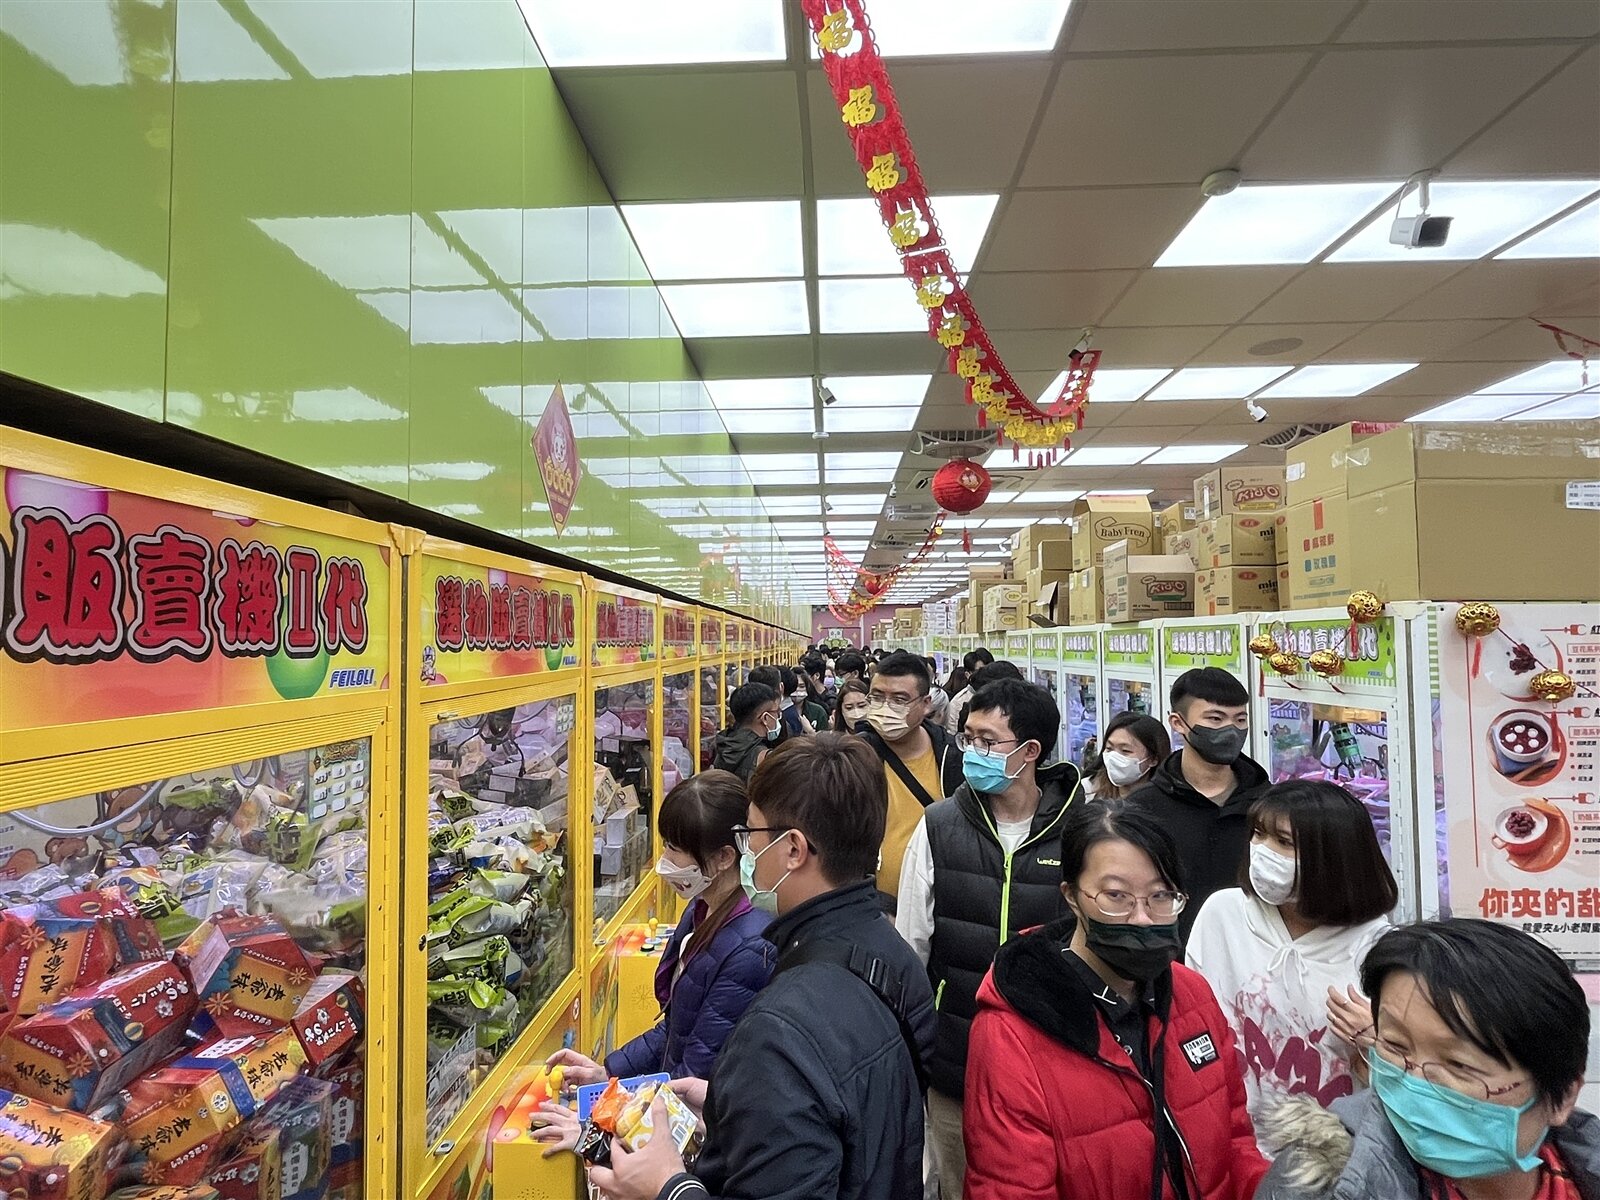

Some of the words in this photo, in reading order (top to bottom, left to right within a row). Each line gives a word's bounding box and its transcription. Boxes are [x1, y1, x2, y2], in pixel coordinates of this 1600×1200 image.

[819, 9, 853, 53] 福
[842, 84, 876, 127] 福
[867, 152, 899, 193] 福
[1101, 528, 1122, 538] Baby
[329, 668, 375, 688] FEILOLI
